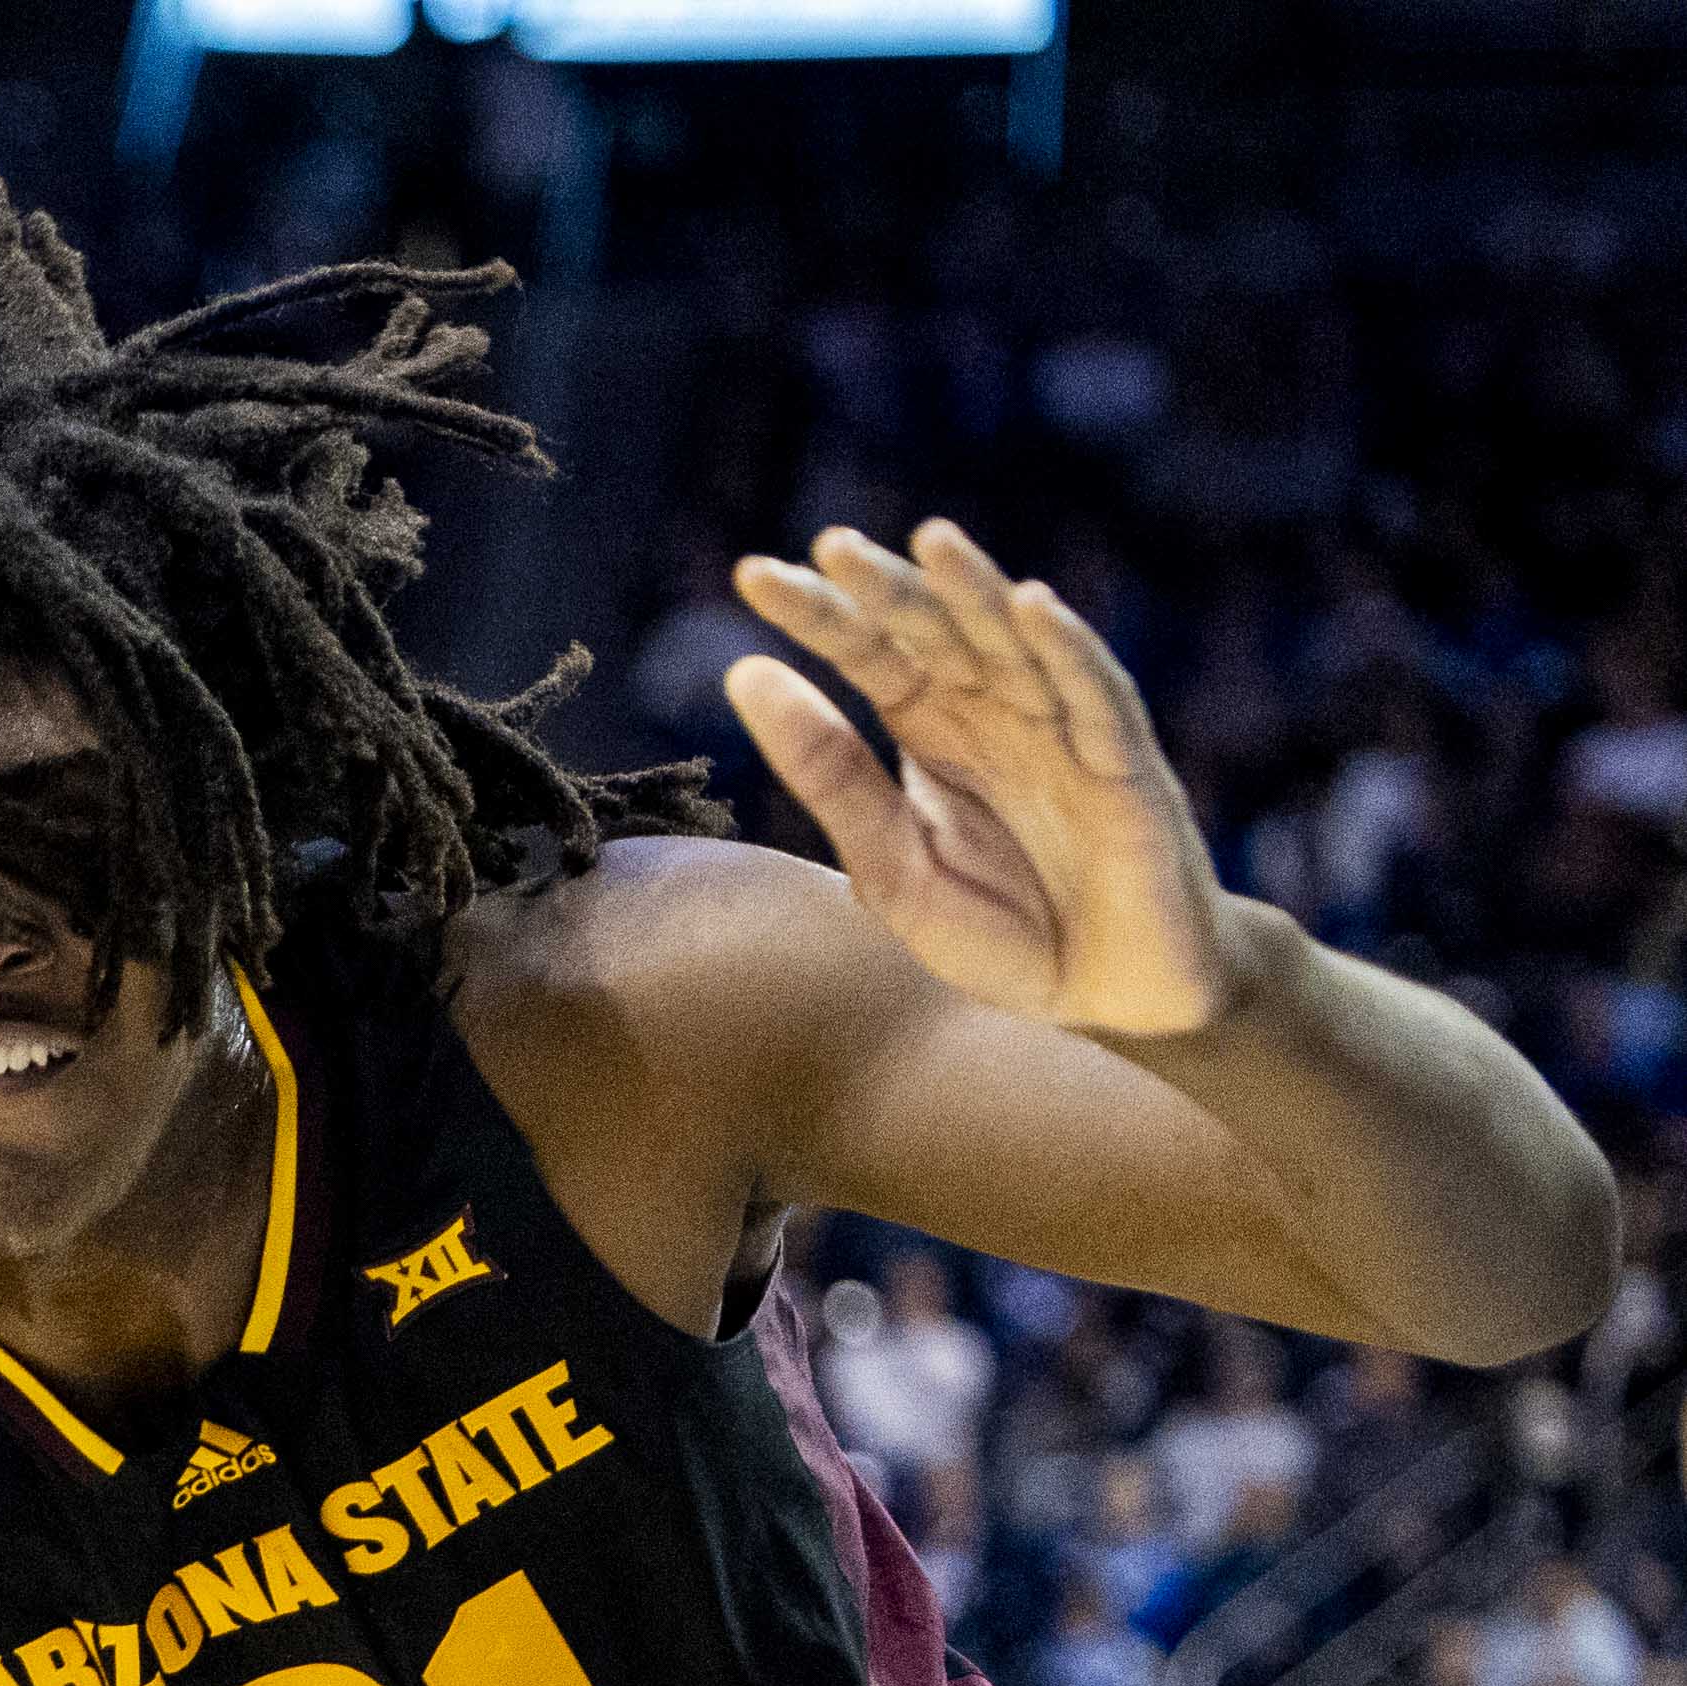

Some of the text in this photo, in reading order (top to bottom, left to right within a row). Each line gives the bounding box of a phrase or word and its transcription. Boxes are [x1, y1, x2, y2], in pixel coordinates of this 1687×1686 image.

[363, 1215, 494, 1328] XII
[172, 1443, 277, 1510] adidas
[321, 1359, 615, 1575] STATE
